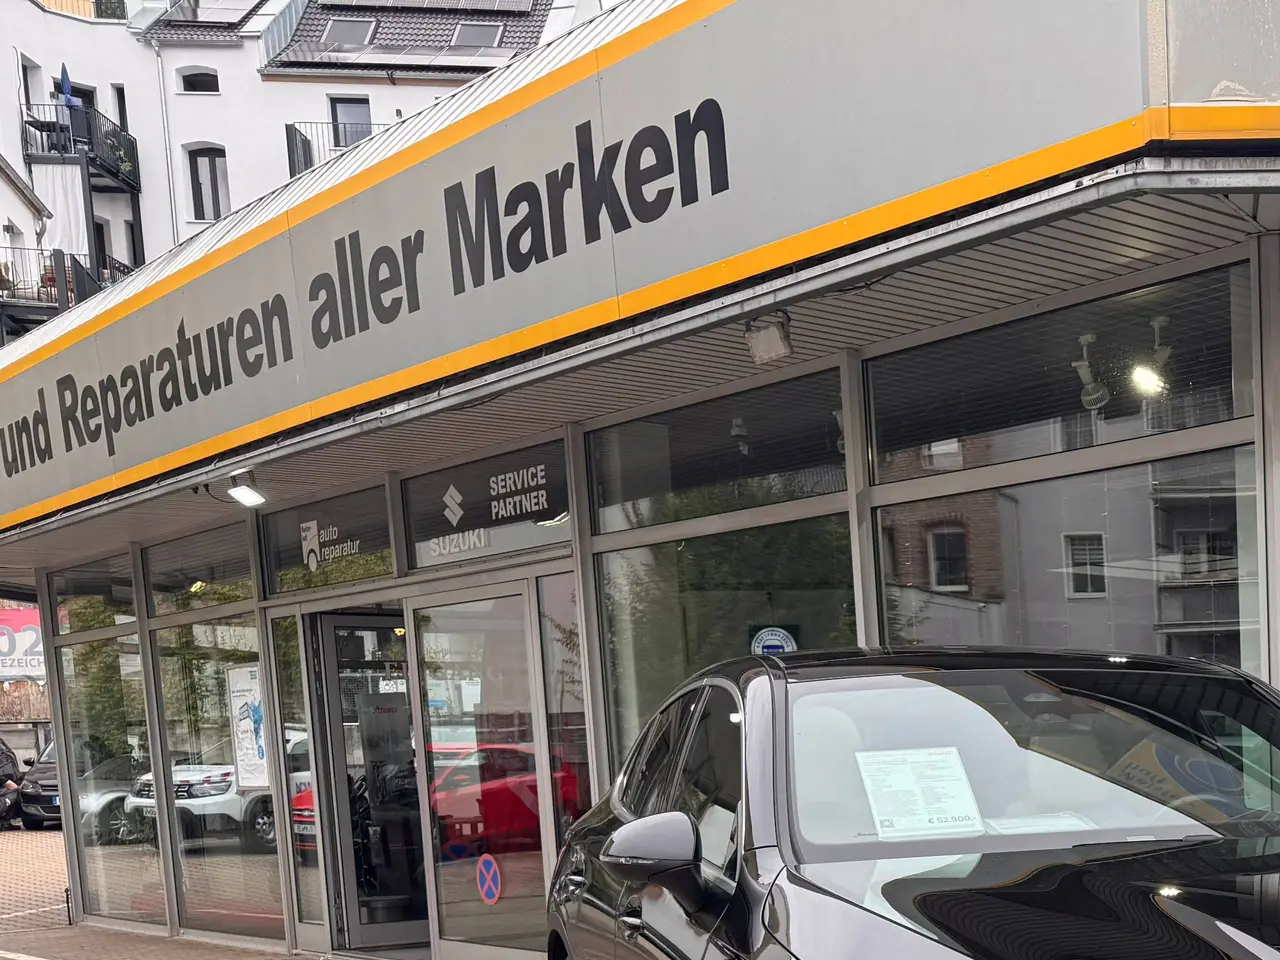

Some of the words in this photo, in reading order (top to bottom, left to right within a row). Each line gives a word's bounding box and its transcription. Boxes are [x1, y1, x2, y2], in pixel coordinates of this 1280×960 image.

[0, 388, 53, 478] und
[56, 293, 293, 457] Reparaturen
[308, 230, 425, 349] aller
[444, 98, 729, 296] Marken
[490, 464, 546, 496] SERVICE
[491, 490, 548, 520] PARTNER
[320, 525, 338, 542] auto
[430, 528, 485, 557] SUZUKI
[321, 540, 360, 562] reparatur
